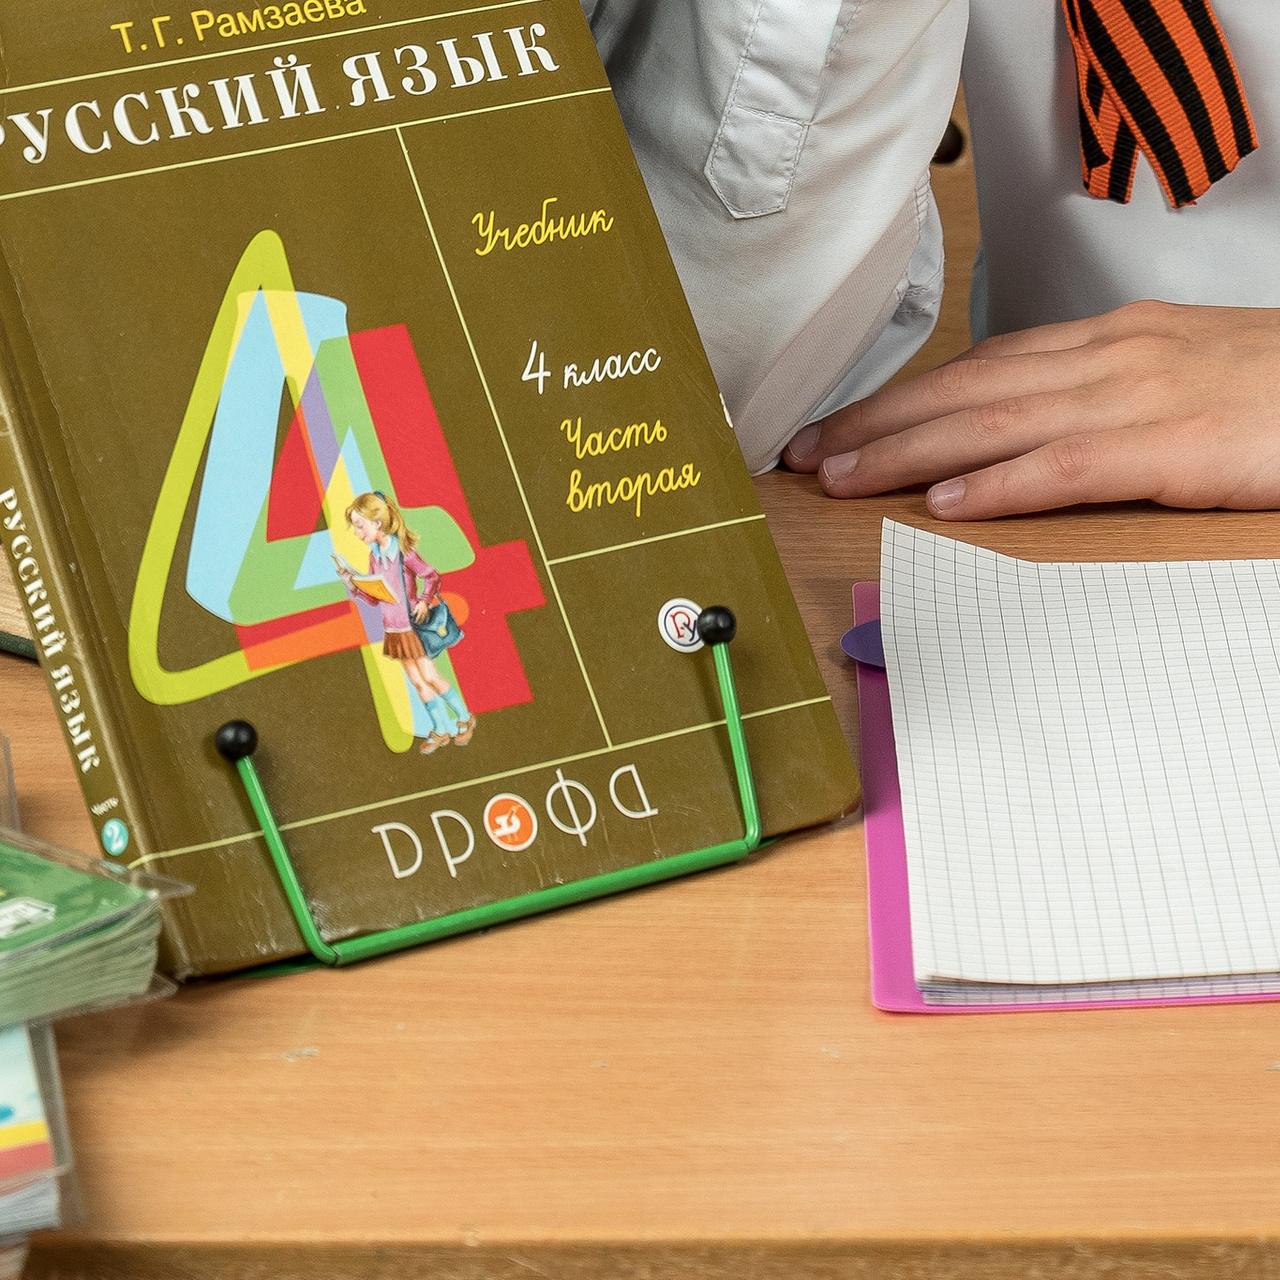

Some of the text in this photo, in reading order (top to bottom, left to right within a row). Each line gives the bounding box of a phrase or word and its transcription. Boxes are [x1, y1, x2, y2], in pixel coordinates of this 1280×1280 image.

[110, 21, 147, 54] Т.
[151, 15, 184, 49] Г.
[341, 22, 560, 108] ЯЗЫК
[471, 197, 614, 256] Учебник
[521, 339, 662, 395] 4 класс
[560, 416, 668, 459] Часть
[566, 462, 701, 517] вторая
[0, 486, 100, 774] РУССКИЙ ЯЗЫК
[105, 821, 124, 853] 2
